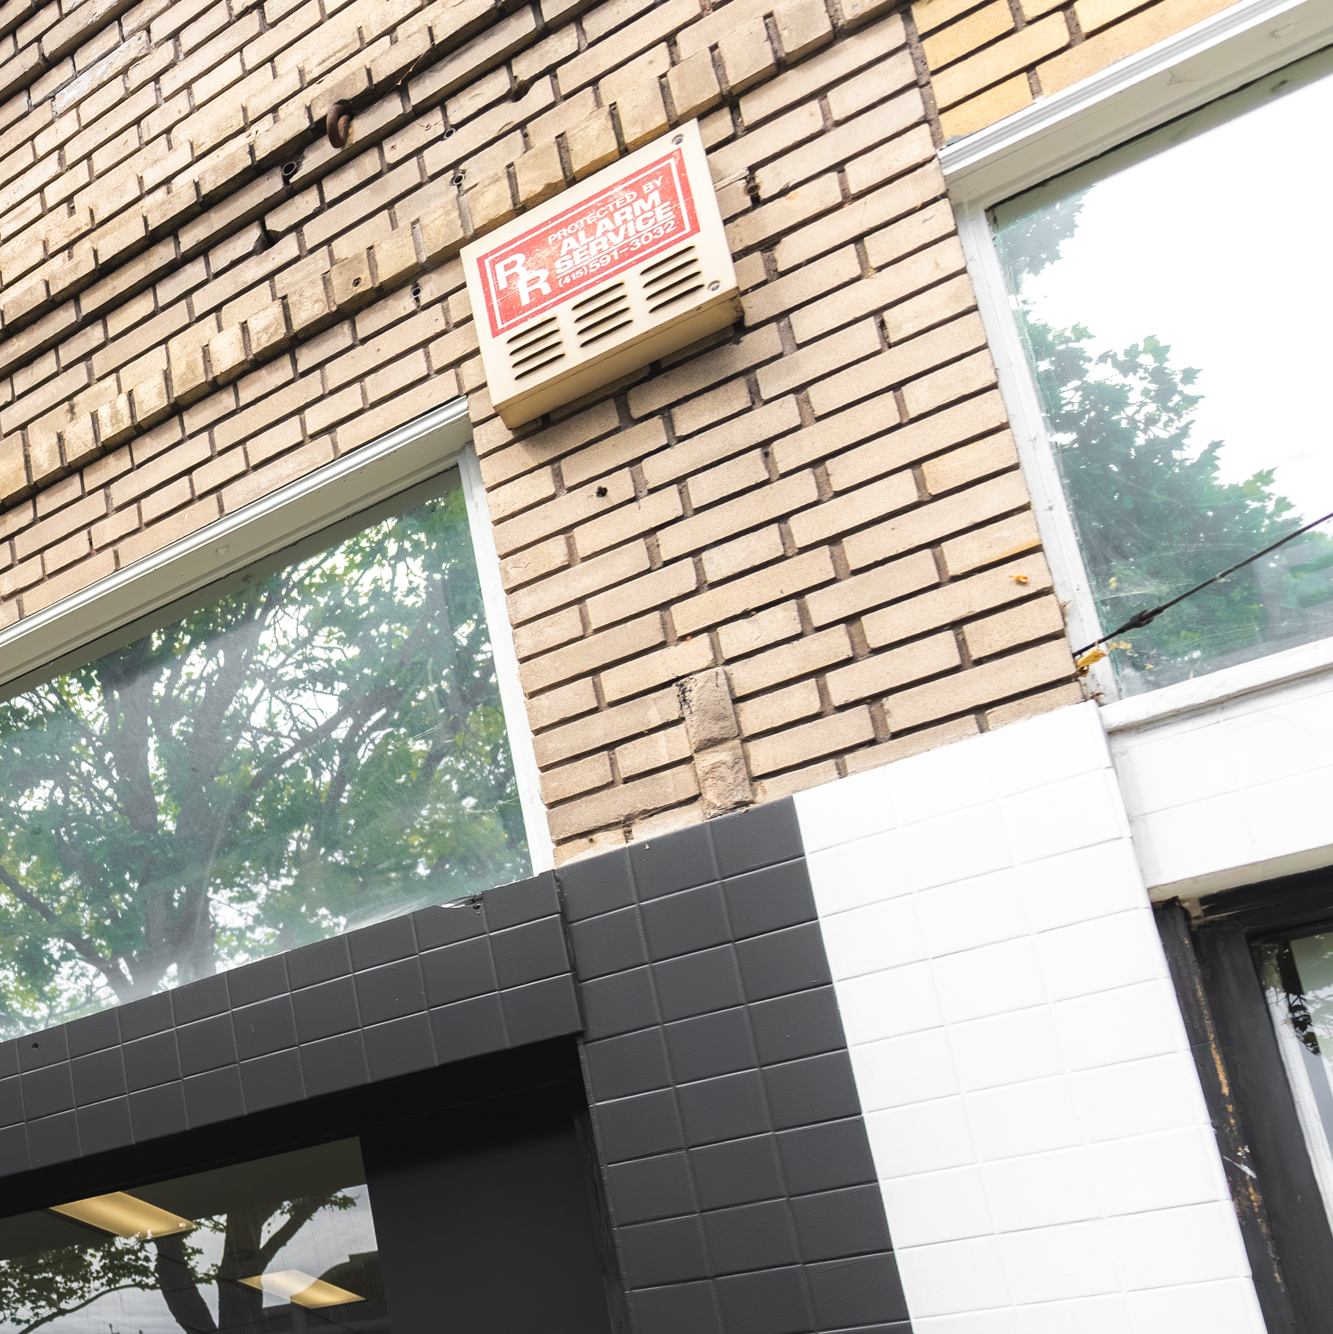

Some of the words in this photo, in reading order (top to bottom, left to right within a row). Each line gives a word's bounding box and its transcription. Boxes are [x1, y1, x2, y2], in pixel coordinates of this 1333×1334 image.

[548, 191, 637, 245] PROTECTED
[642, 175, 664, 194] BY
[554, 201, 674, 274] SERVICE
[560, 190, 663, 257] ALARM
